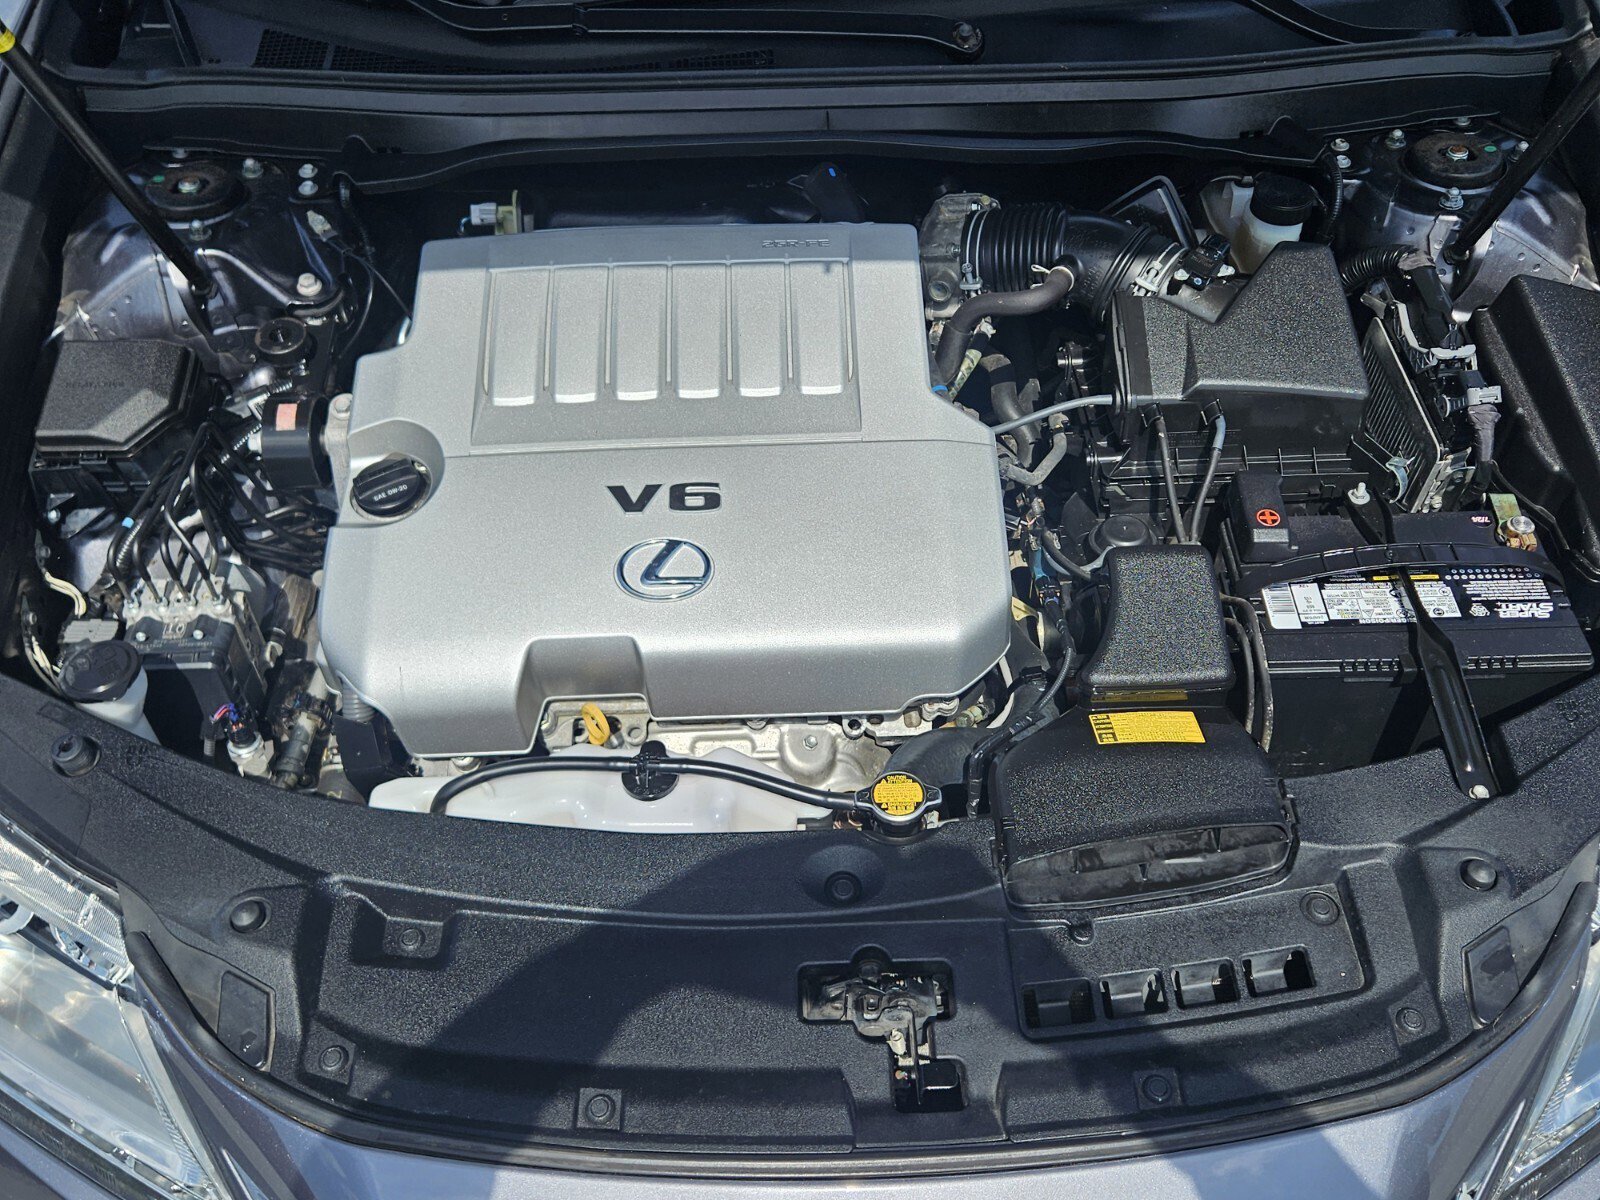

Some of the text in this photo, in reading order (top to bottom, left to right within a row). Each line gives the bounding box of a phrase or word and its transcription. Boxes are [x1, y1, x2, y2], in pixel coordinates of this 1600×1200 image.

[762, 238, 830, 248] 2GR-FE
[373, 492, 387, 502] SAE
[606, 482, 722, 513] V6
[1498, 610, 1551, 618] SUPER
